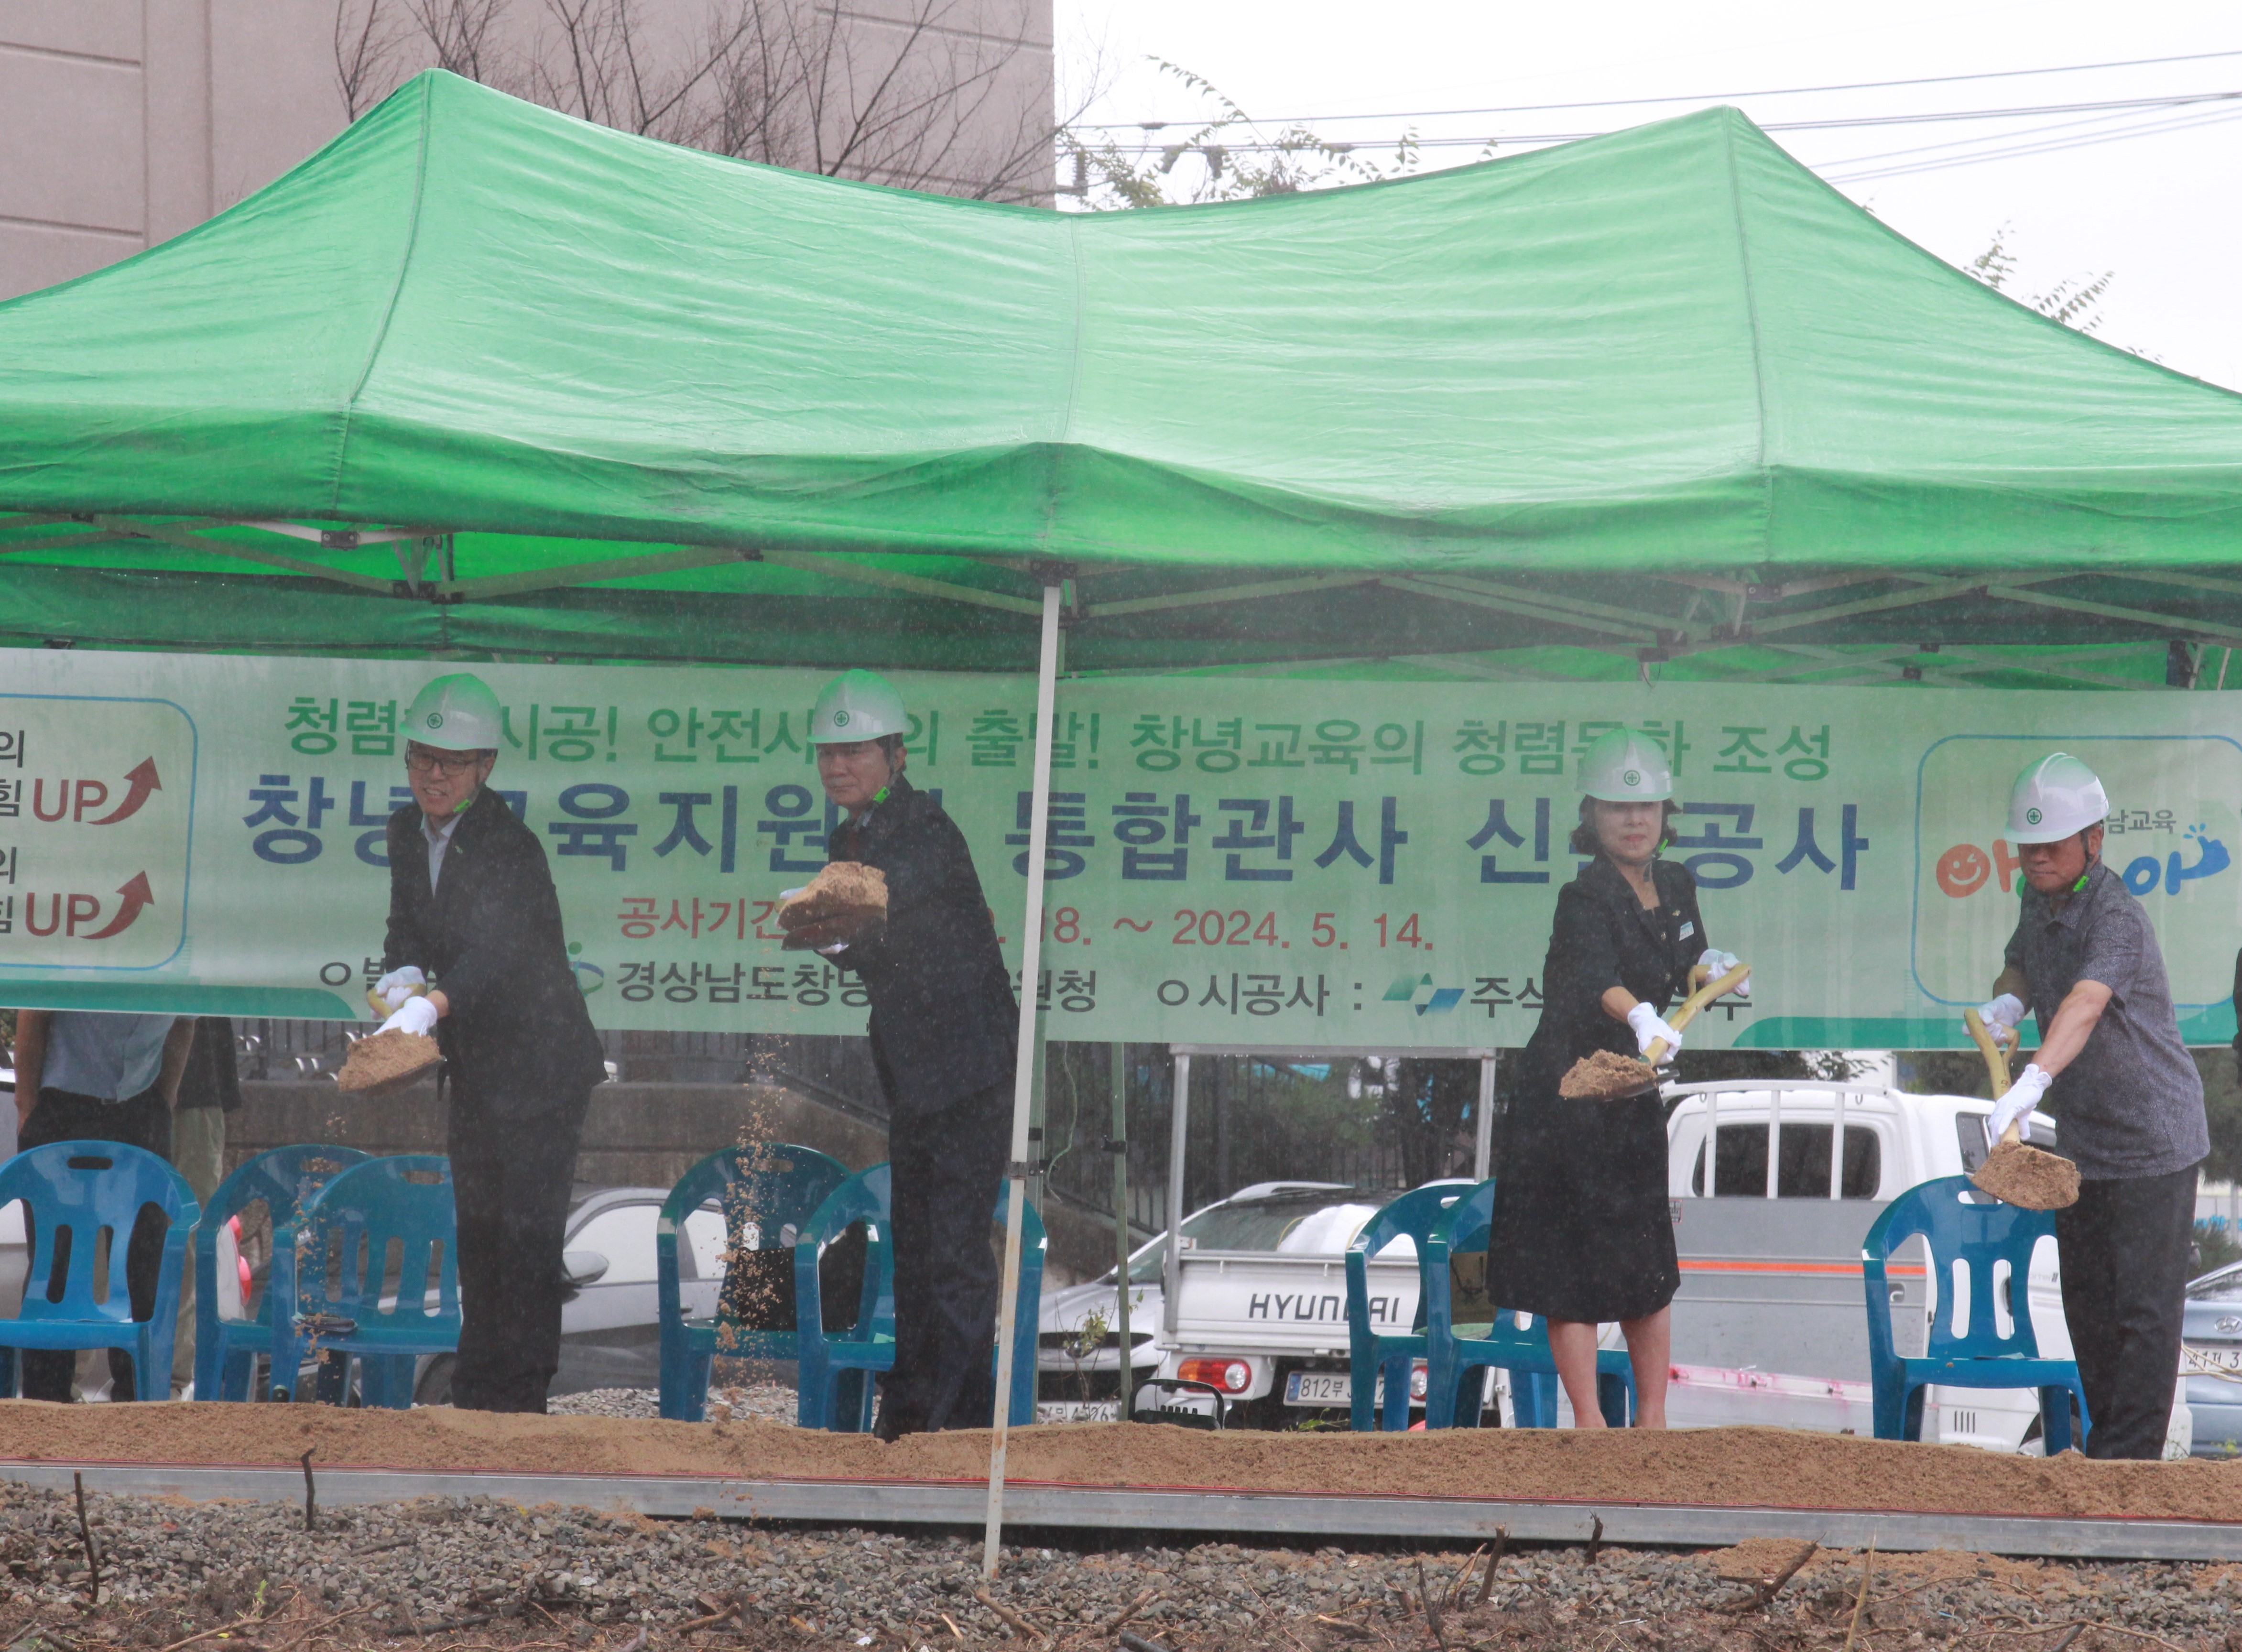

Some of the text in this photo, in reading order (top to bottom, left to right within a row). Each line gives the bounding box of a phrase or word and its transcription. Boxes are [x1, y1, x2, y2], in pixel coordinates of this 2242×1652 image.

[285, 697, 411, 756] 청렴
[648, 707, 939, 766] 안전시의
[965, 709, 1100, 771] 출발!
[1129, 714, 1425, 775] 창녕교육의
[1713, 726, 1830, 782] 조성
[2101, 809, 2177, 834] 남교육
[1005, 791, 1408, 885] 통합관사
[1466, 797, 1870, 891] 신공사
[1172, 910, 1290, 948] 2024.
[1311, 912, 1349, 950] 5.
[1373, 913, 1434, 951] 14.
[1248, 1293, 1400, 1324] HYUNAI
[1300, 1378, 1343, 1399] 812부
